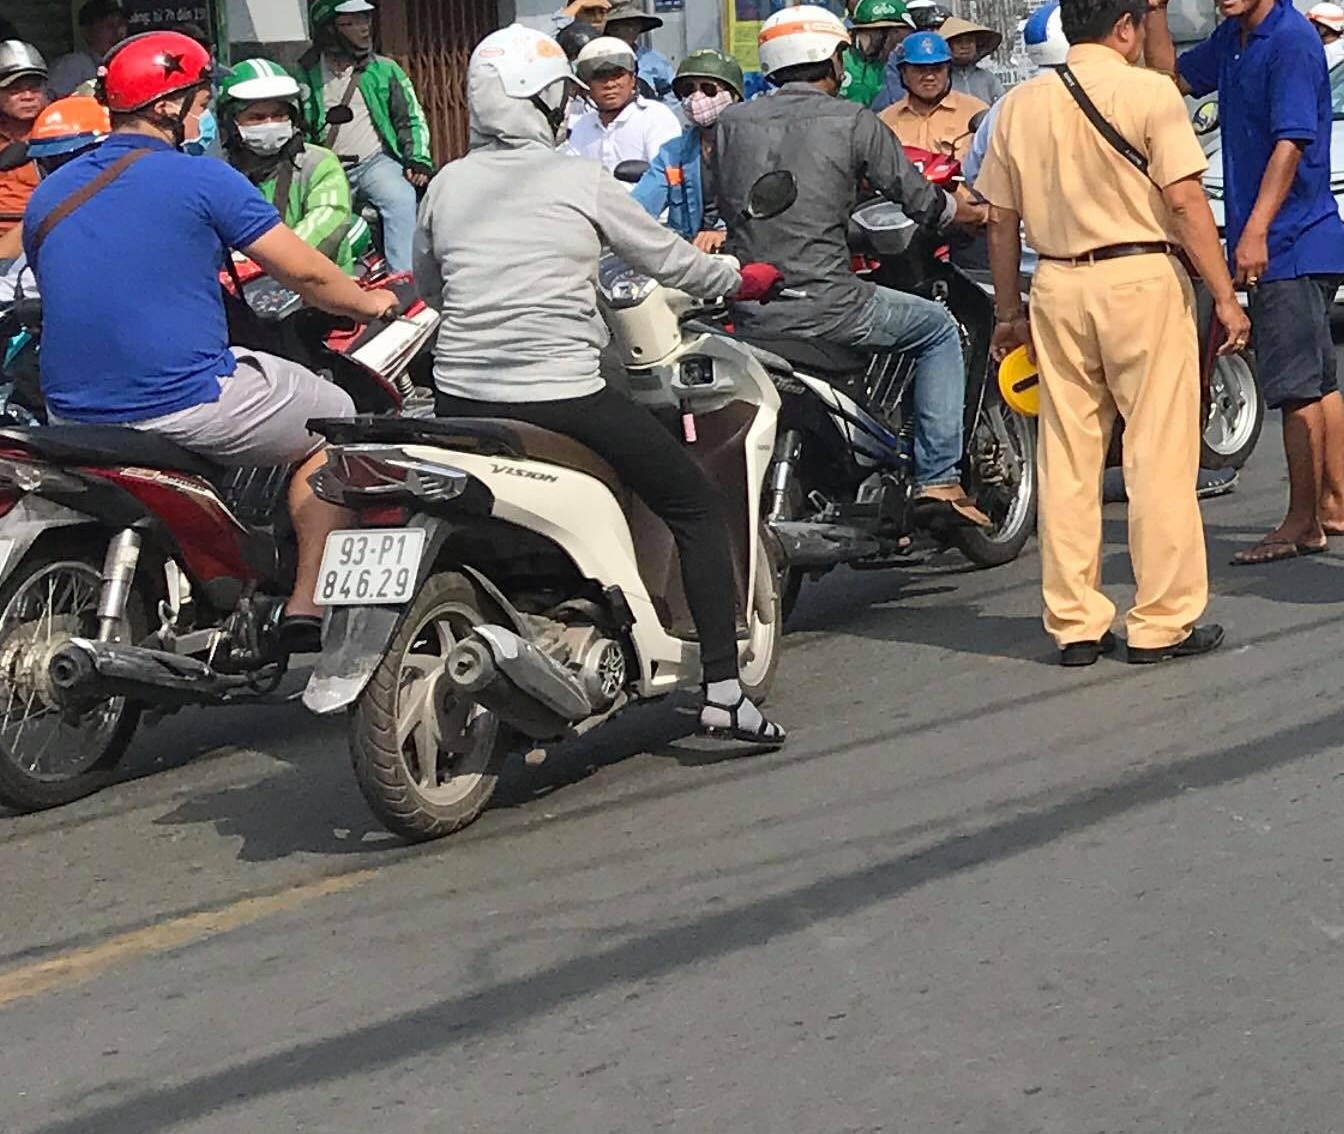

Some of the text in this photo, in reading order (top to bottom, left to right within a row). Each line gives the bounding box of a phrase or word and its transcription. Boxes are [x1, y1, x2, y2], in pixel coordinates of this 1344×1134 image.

[489, 462, 559, 483] VISION
[339, 535, 407, 565] 93-P1
[322, 568, 410, 599] 846.29
